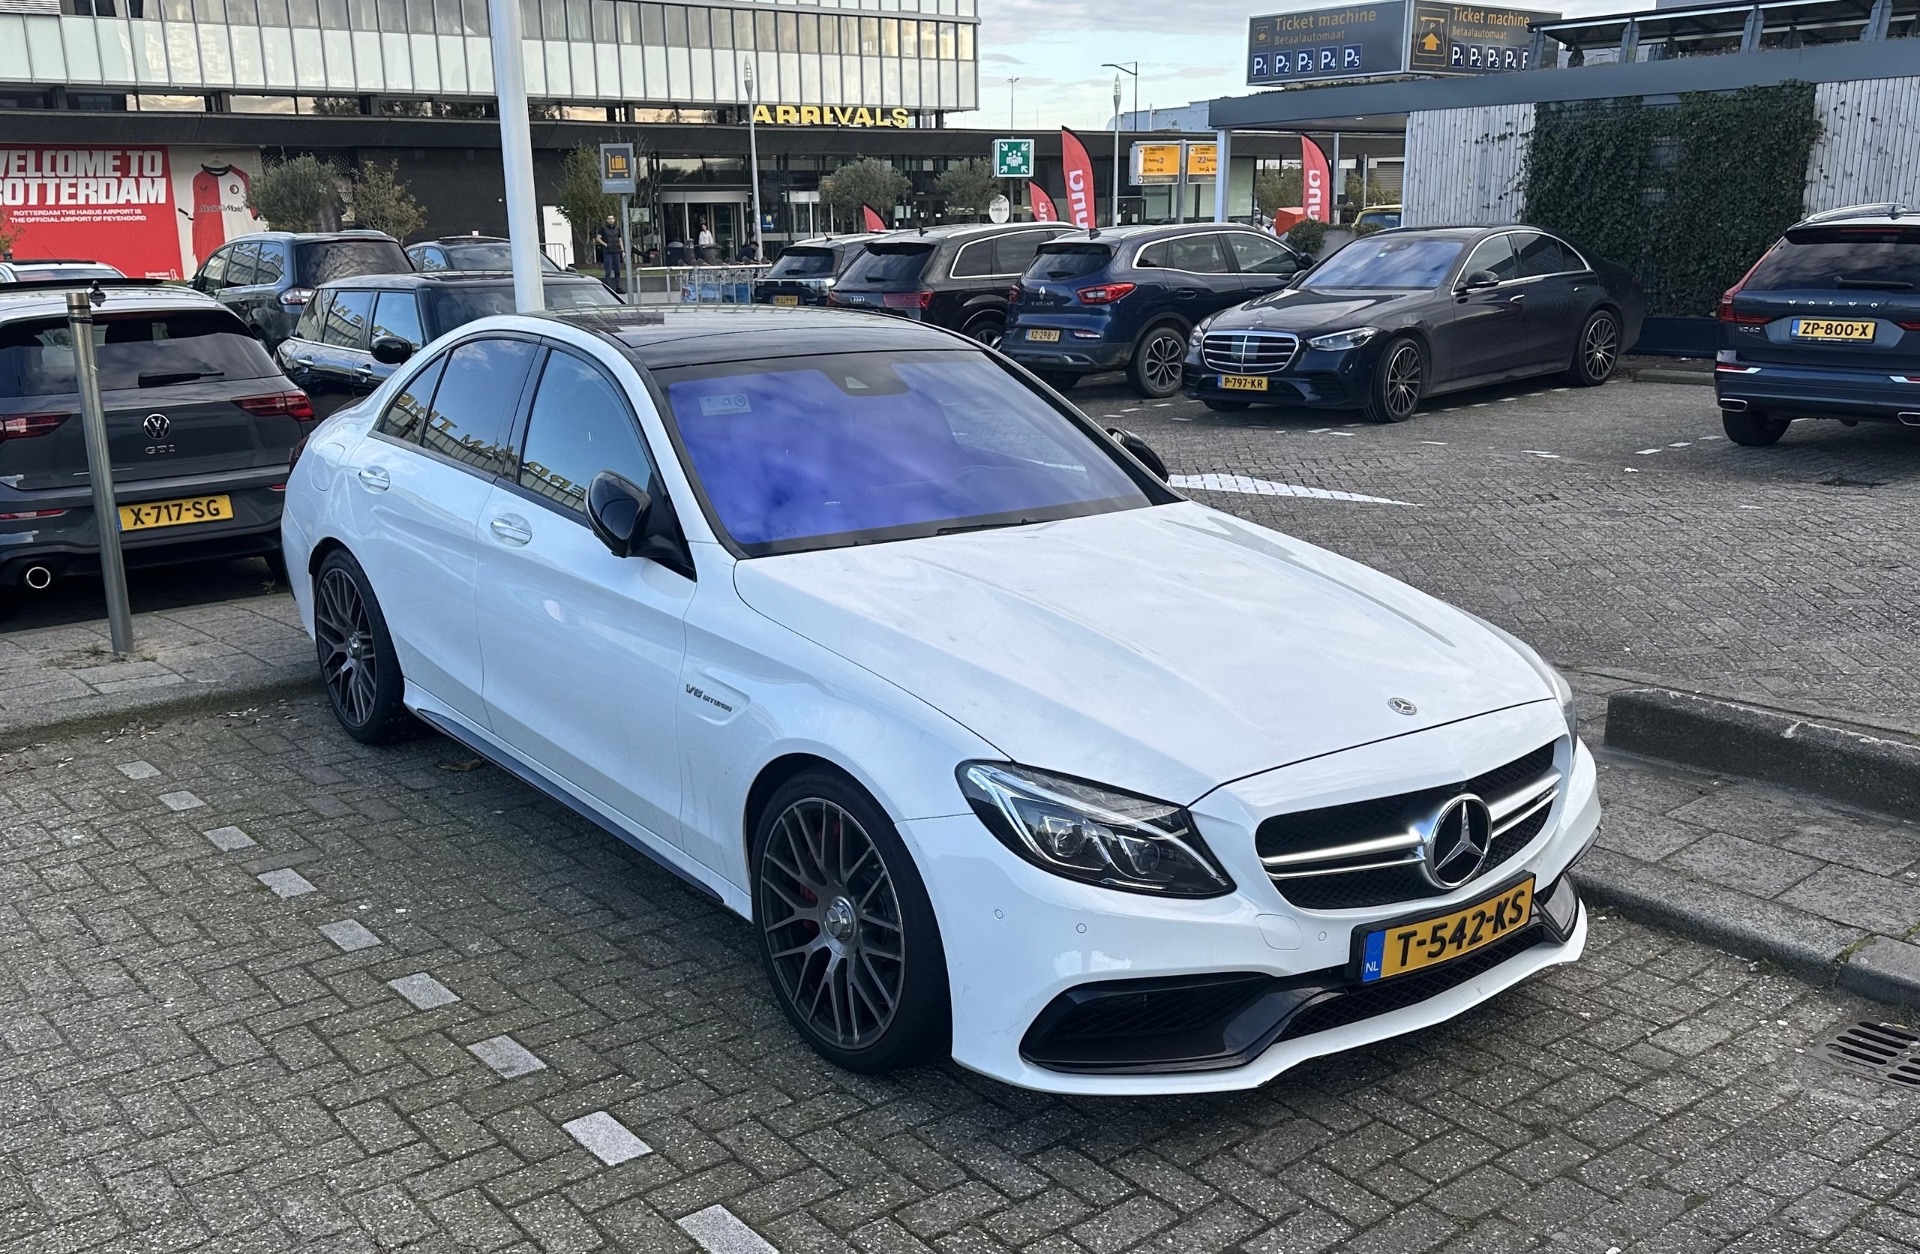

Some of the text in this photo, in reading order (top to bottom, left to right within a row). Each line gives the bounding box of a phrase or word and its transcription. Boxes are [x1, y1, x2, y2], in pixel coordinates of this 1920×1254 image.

[1275, 9, 1377, 32] Ticket machine
[1453, 7, 1530, 28] Ticket machine
[1274, 31, 1345, 46] Betaalautomaat
[1451, 26, 1507, 41] Betaalautomaat
[753, 104, 909, 129] ARRIVALS
[127, 151, 163, 177] TO
[0, 178, 167, 206] OTTERDAM
[13, 209, 61, 217] ROTTERDAM
[76, 208, 102, 216] HAGUE
[1030, 330, 1058, 341] XZ-298-J
[1801, 322, 1869, 337] ZP-800-X
[1224, 376, 1263, 389] P-797-KR
[145, 444, 175, 454] GTI
[130, 499, 221, 526] X-717-SG
[1397, 889, 1526, 967] T-542-KS
[1365, 962, 1379, 973] NL
